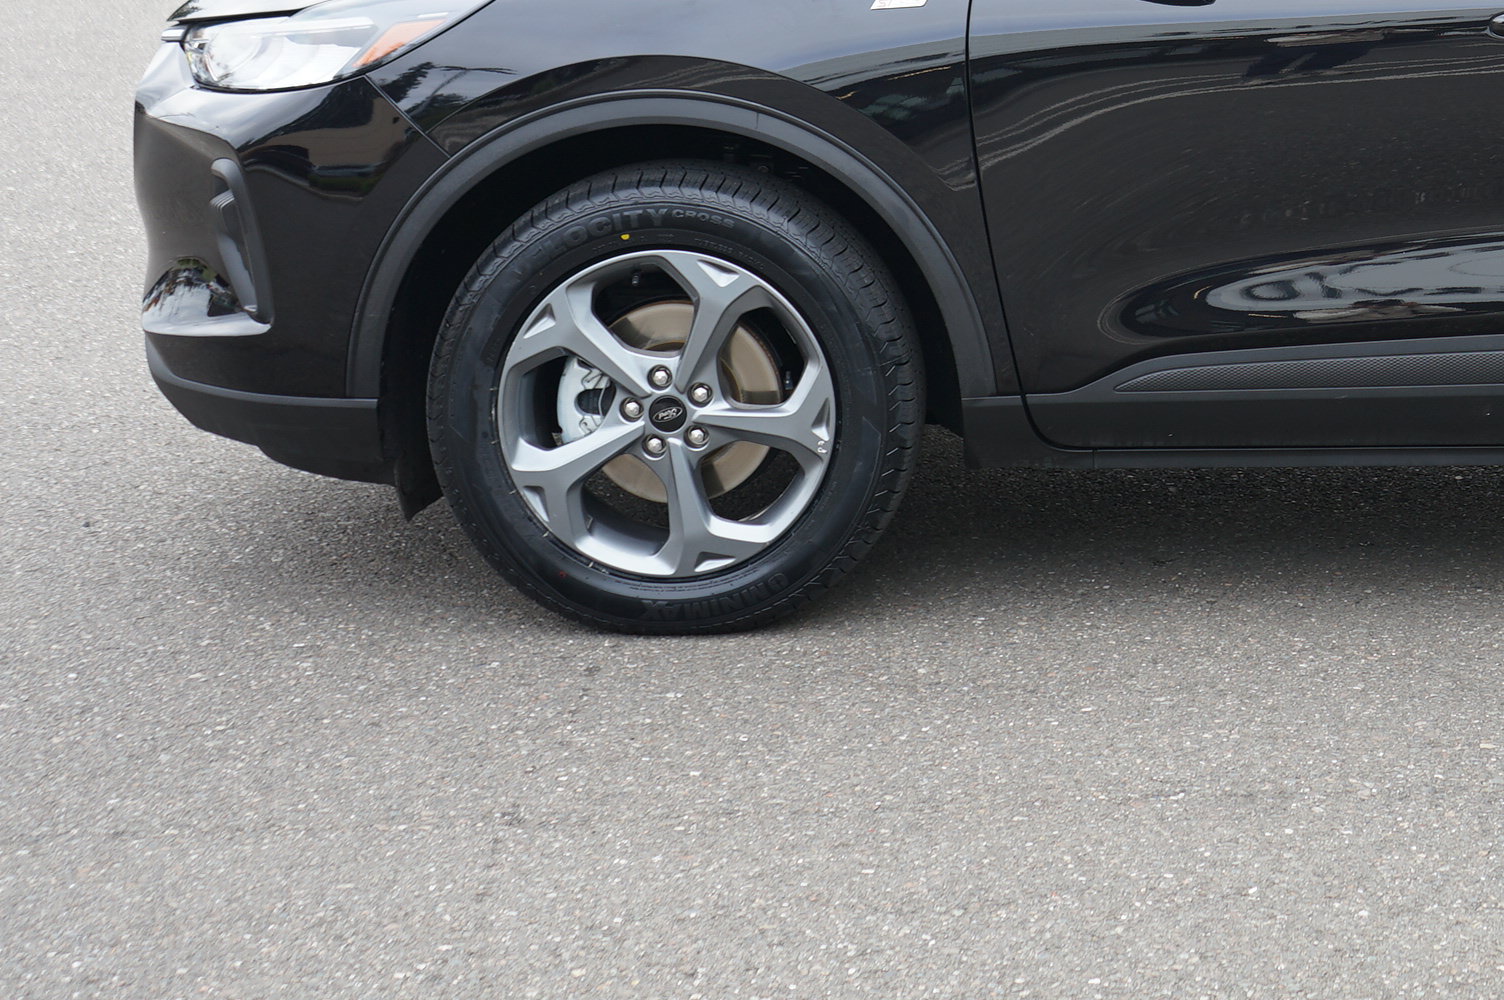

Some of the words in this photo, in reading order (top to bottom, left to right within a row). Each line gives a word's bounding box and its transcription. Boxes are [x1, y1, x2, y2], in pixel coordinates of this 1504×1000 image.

[671, 209, 738, 229] CROSS
[656, 407, 679, 421] Ford
[641, 572, 789, 622] OMNIMAX
